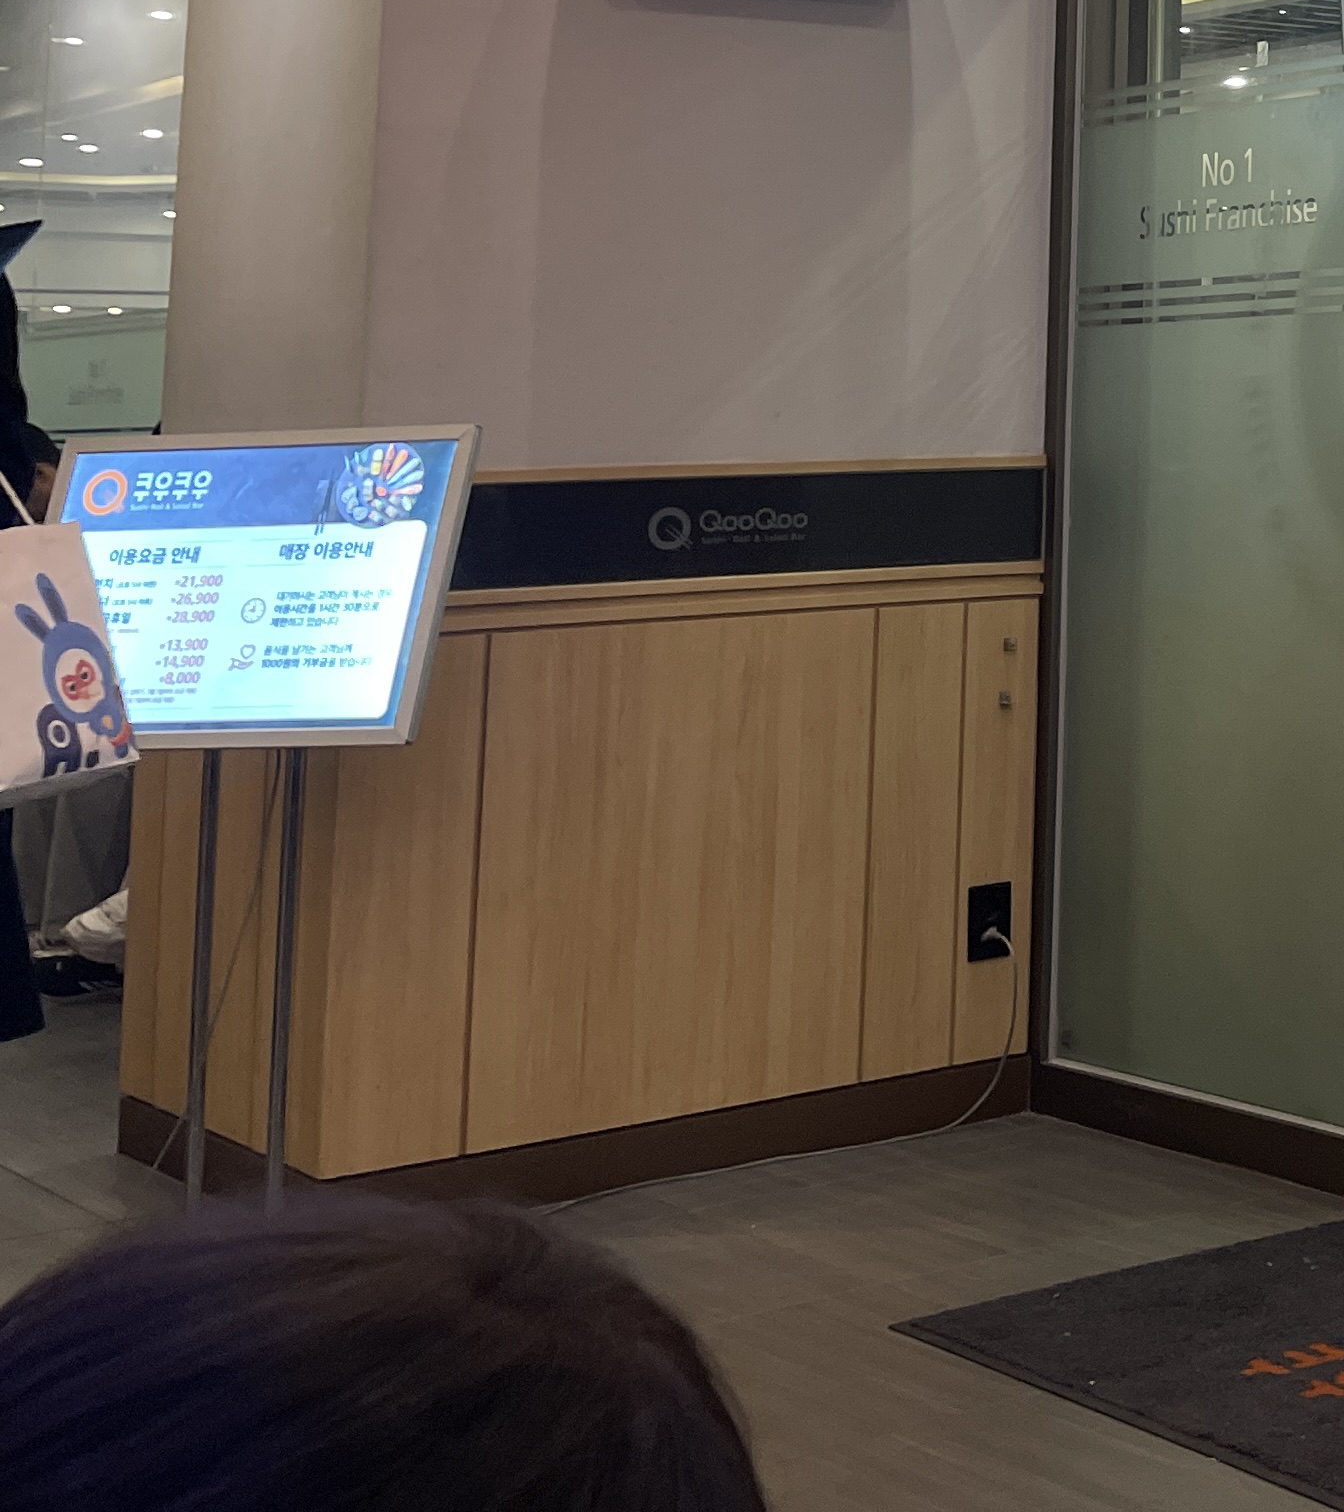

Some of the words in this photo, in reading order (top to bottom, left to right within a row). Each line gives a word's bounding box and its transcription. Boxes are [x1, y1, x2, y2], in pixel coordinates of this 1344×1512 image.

[1201, 152, 1235, 188] No
[1243, 148, 1254, 183] 1
[1204, 189, 1319, 233] Franchise
[133, 470, 214, 503] 쿠우쿠우
[700, 507, 809, 532] QooQoo
[109, 547, 167, 566] 이용요금
[171, 546, 202, 565] 안내
[278, 543, 310, 561] 매장
[313, 541, 375, 560] 이용안내
